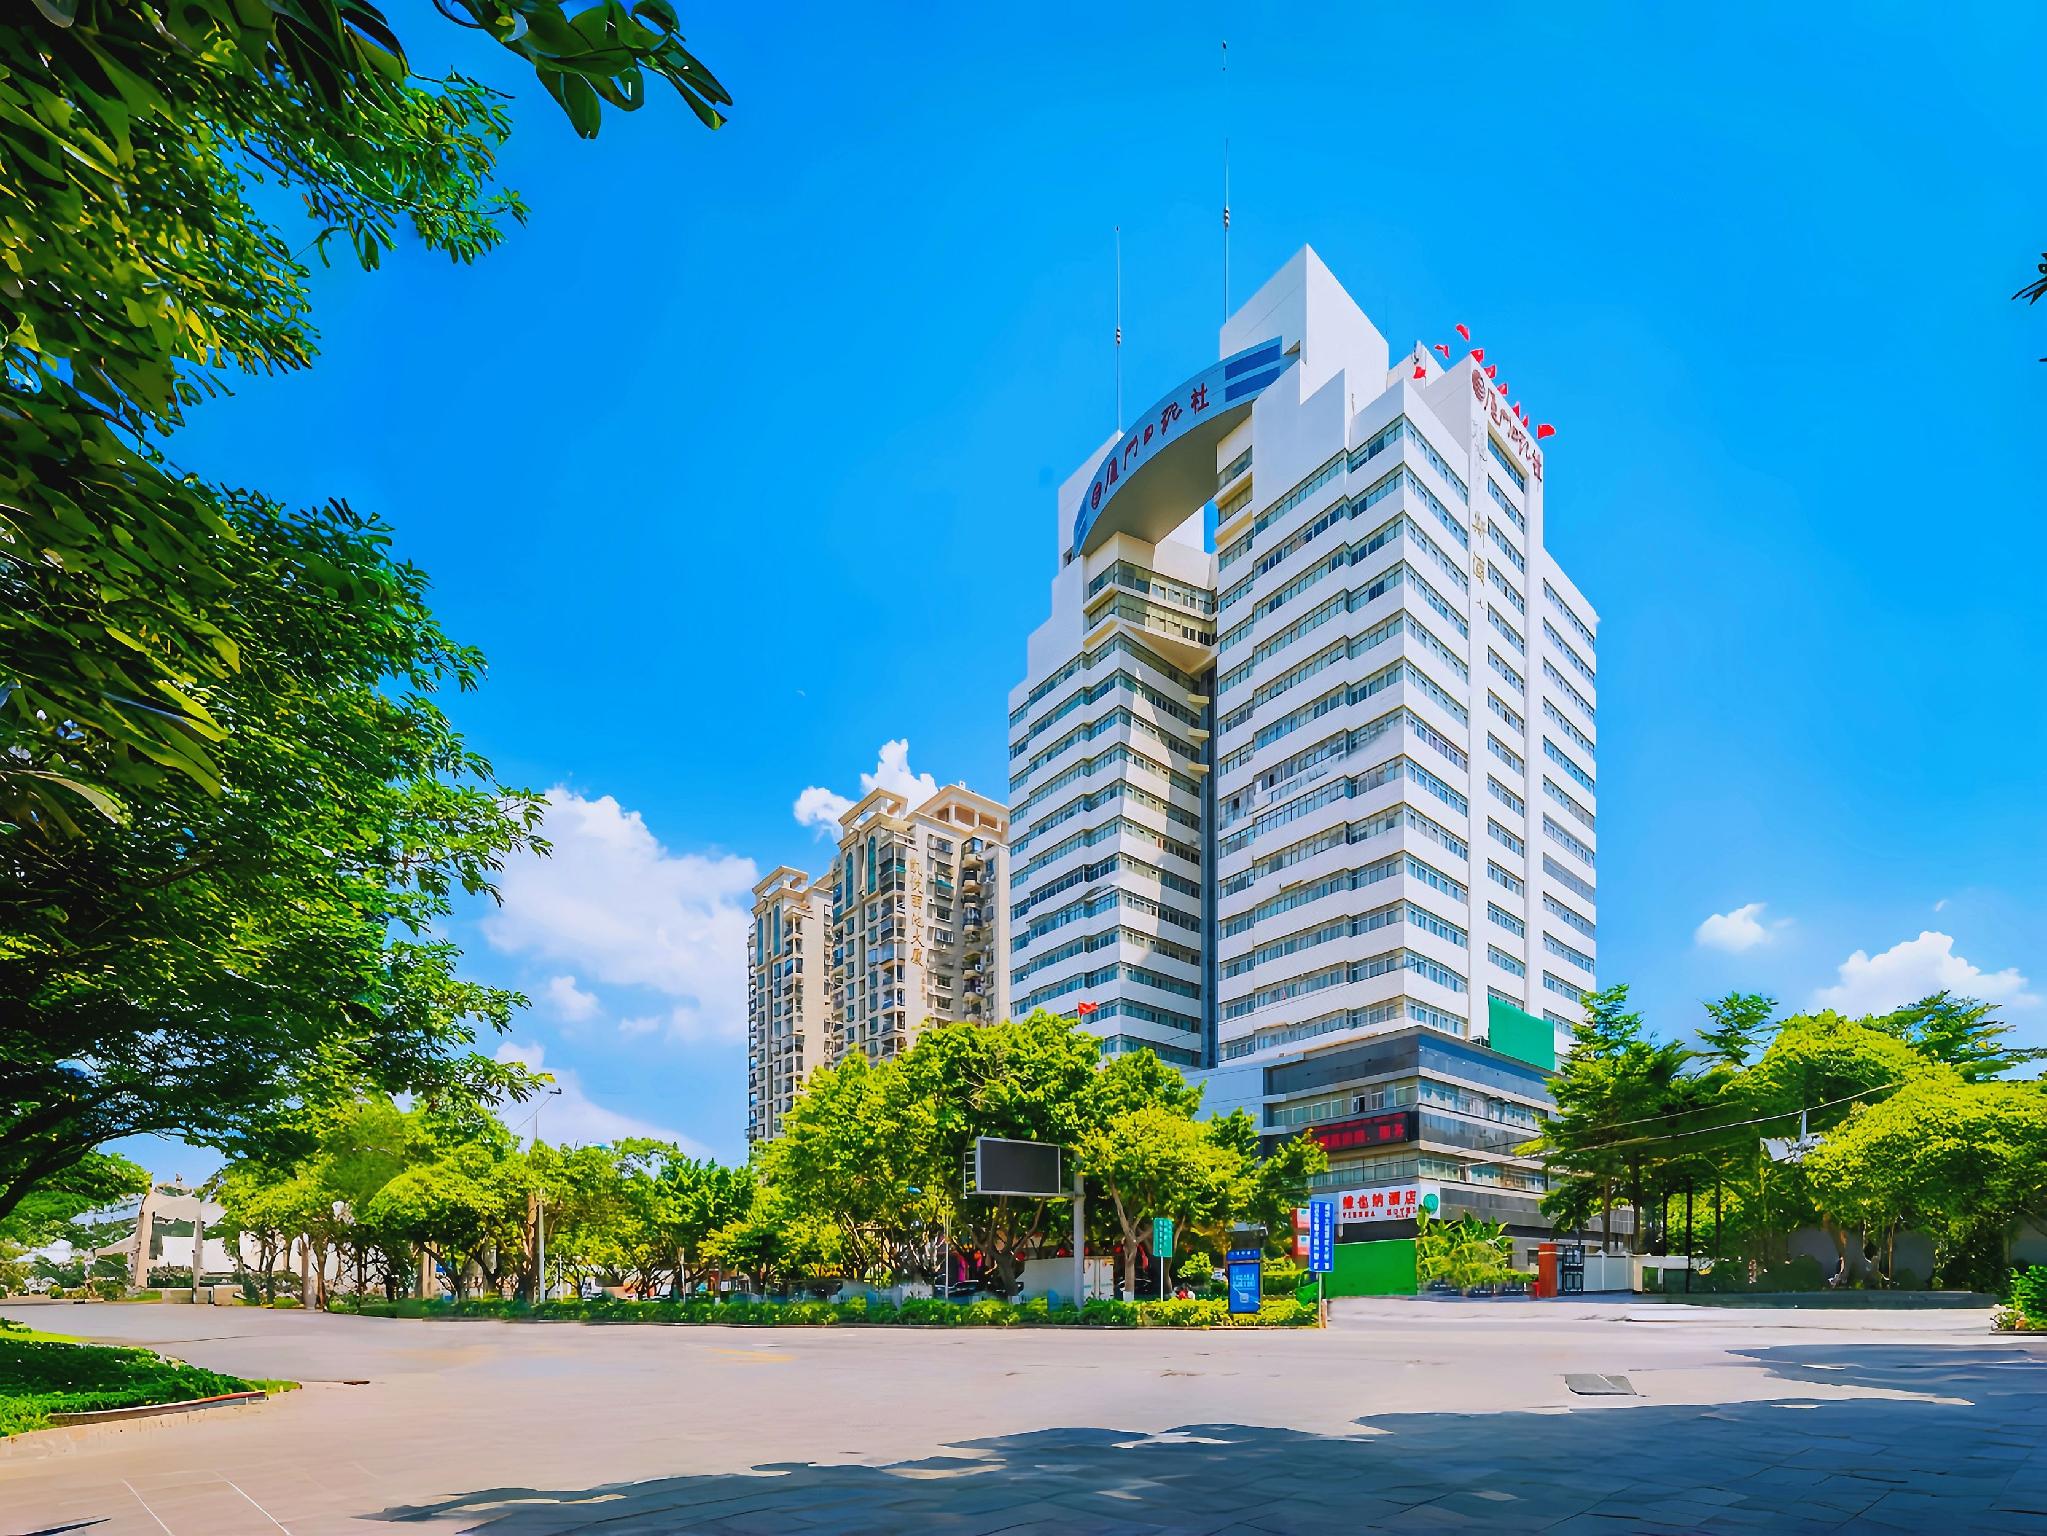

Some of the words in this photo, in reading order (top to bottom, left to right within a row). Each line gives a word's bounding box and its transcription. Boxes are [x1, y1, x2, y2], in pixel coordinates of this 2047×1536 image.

[1342, 1189, 1417, 1210] 维也纳酒店
